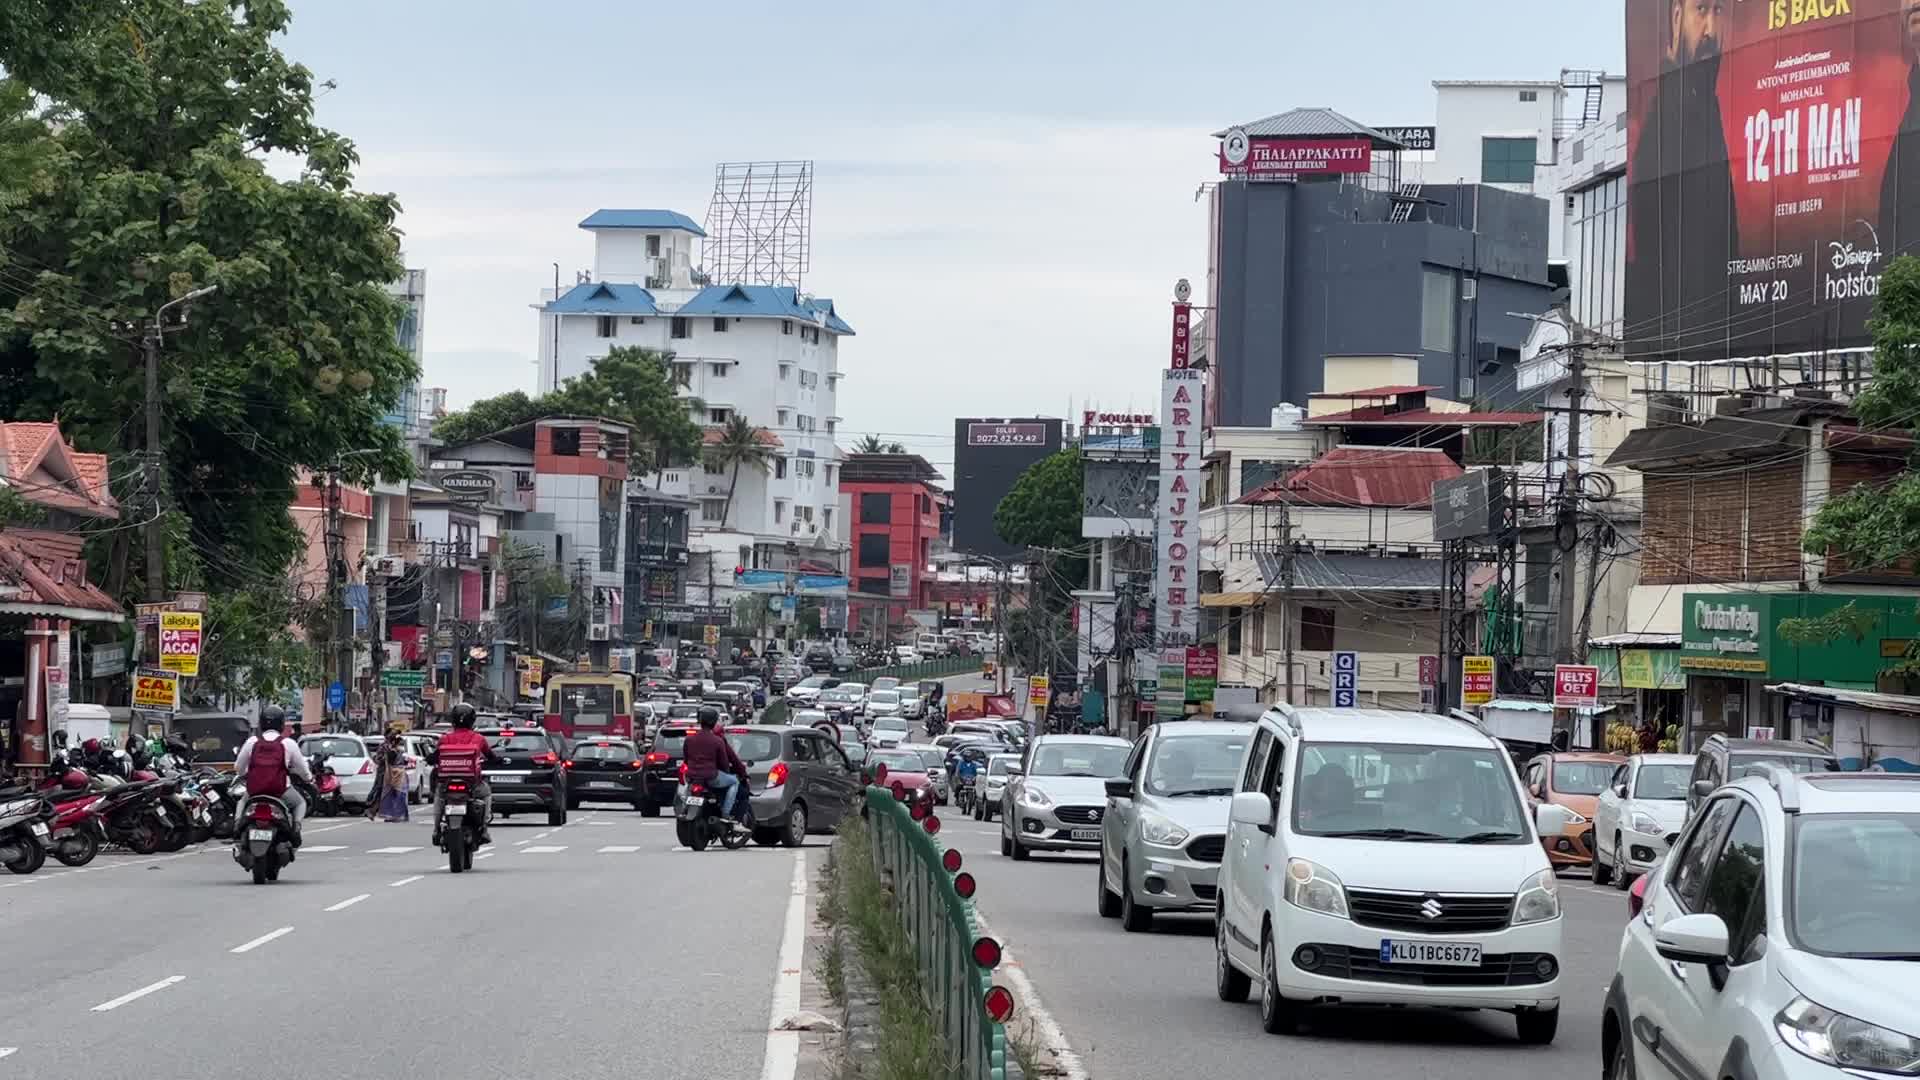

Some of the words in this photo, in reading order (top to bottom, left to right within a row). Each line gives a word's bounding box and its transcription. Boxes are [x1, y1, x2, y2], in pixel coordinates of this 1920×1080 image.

[1768, 0, 1787, 30] IS
[1791, 0, 1851, 25] BACK
[1756, 73, 1789, 90] ANTONY
[1779, 84, 1824, 104] MOHANLAL
[1744, 107, 1800, 182] 12TH
[1808, 97, 1861, 170] MAN
[1252, 147, 1363, 161] THALAPPAKATTI
[1252, 161, 1294, 170] LEGENDARY
[1295, 160, 1328, 169] BIRIYANI
[1799, 198, 1823, 214] JOSEPH
[1728, 256, 1776, 275] STREAMING
[1777, 252, 1803, 270] FROM
[1740, 282, 1769, 305] MAY
[1772, 279, 1788, 301] 20
[1825, 270, 1883, 300] hotstar
[1166, 370, 1199, 380] HOTEL
[1084, 411, 1097, 425] F
[1099, 413, 1154, 425] SQUARE
[1167, 385, 1191, 627] ARIYAJYOTHI
[162, 614, 199, 628] Lakshya
[162, 630, 179, 641] CA
[163, 642, 197, 654] ACCA
[138, 678, 166, 690] CA
[1560, 671, 1593, 683] IELTS
[1563, 682, 1588, 694] OET
[440, 758, 472, 767] zomato
[1391, 943, 1480, 962] KL01BC6672
